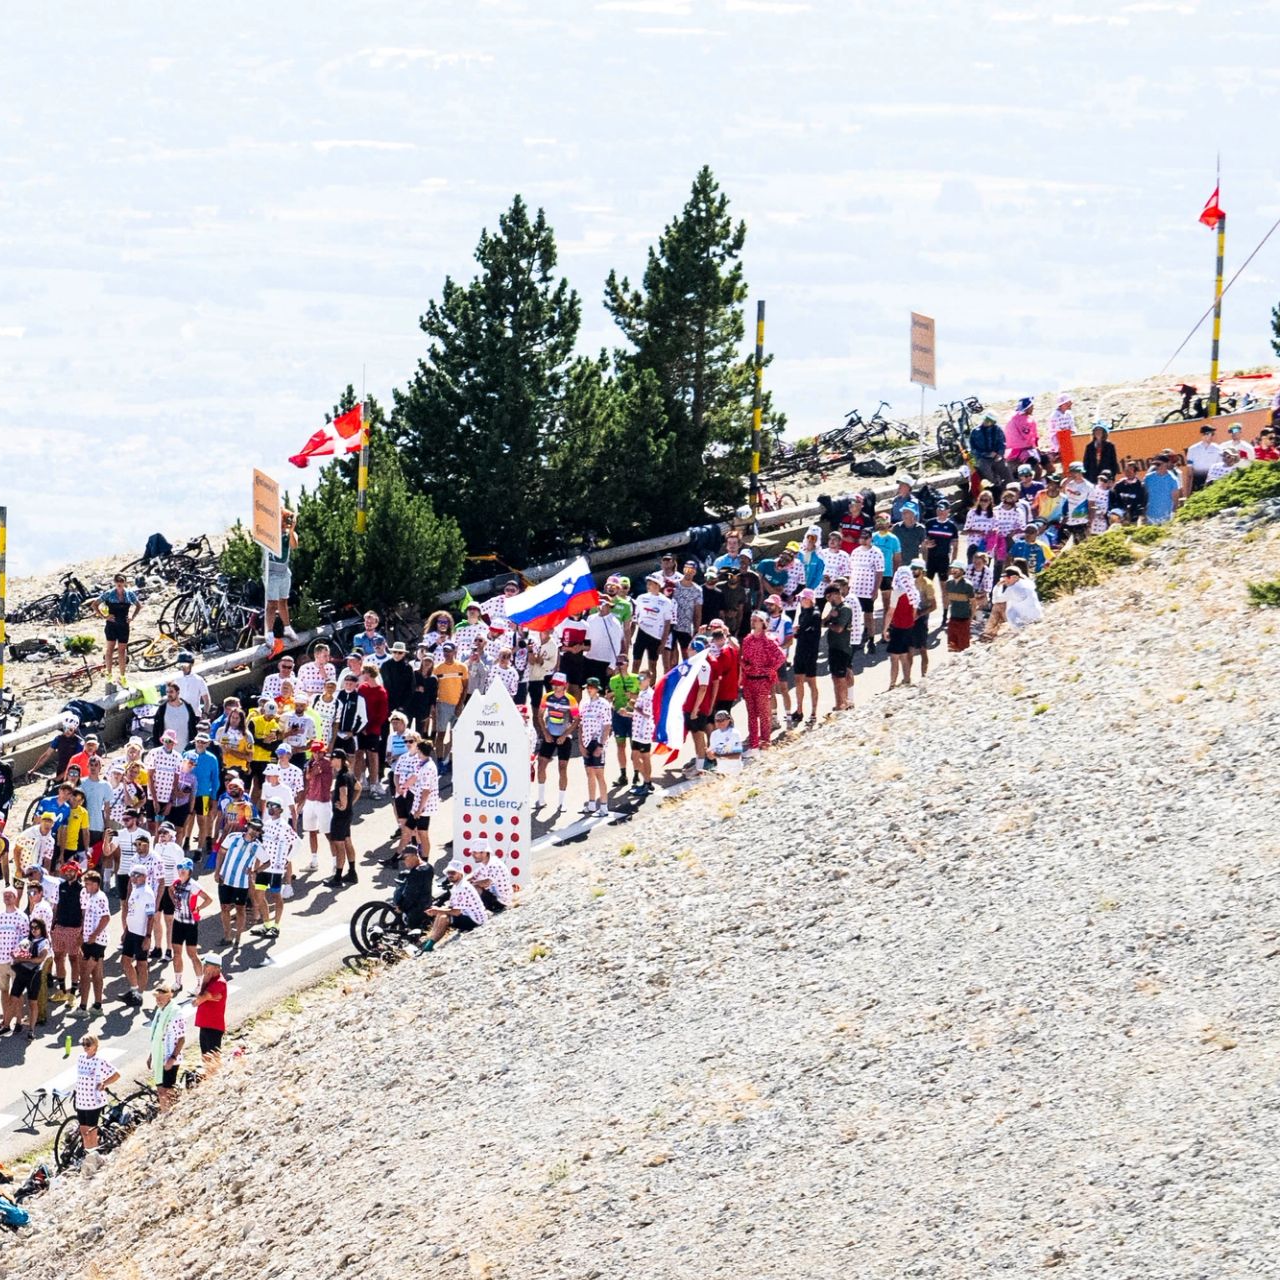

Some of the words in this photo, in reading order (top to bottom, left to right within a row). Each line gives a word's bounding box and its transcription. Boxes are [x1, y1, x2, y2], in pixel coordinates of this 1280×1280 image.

[474, 730, 486, 753] 2
[488, 742, 507, 754] KM
[464, 797, 518, 809] E.Leclerc
